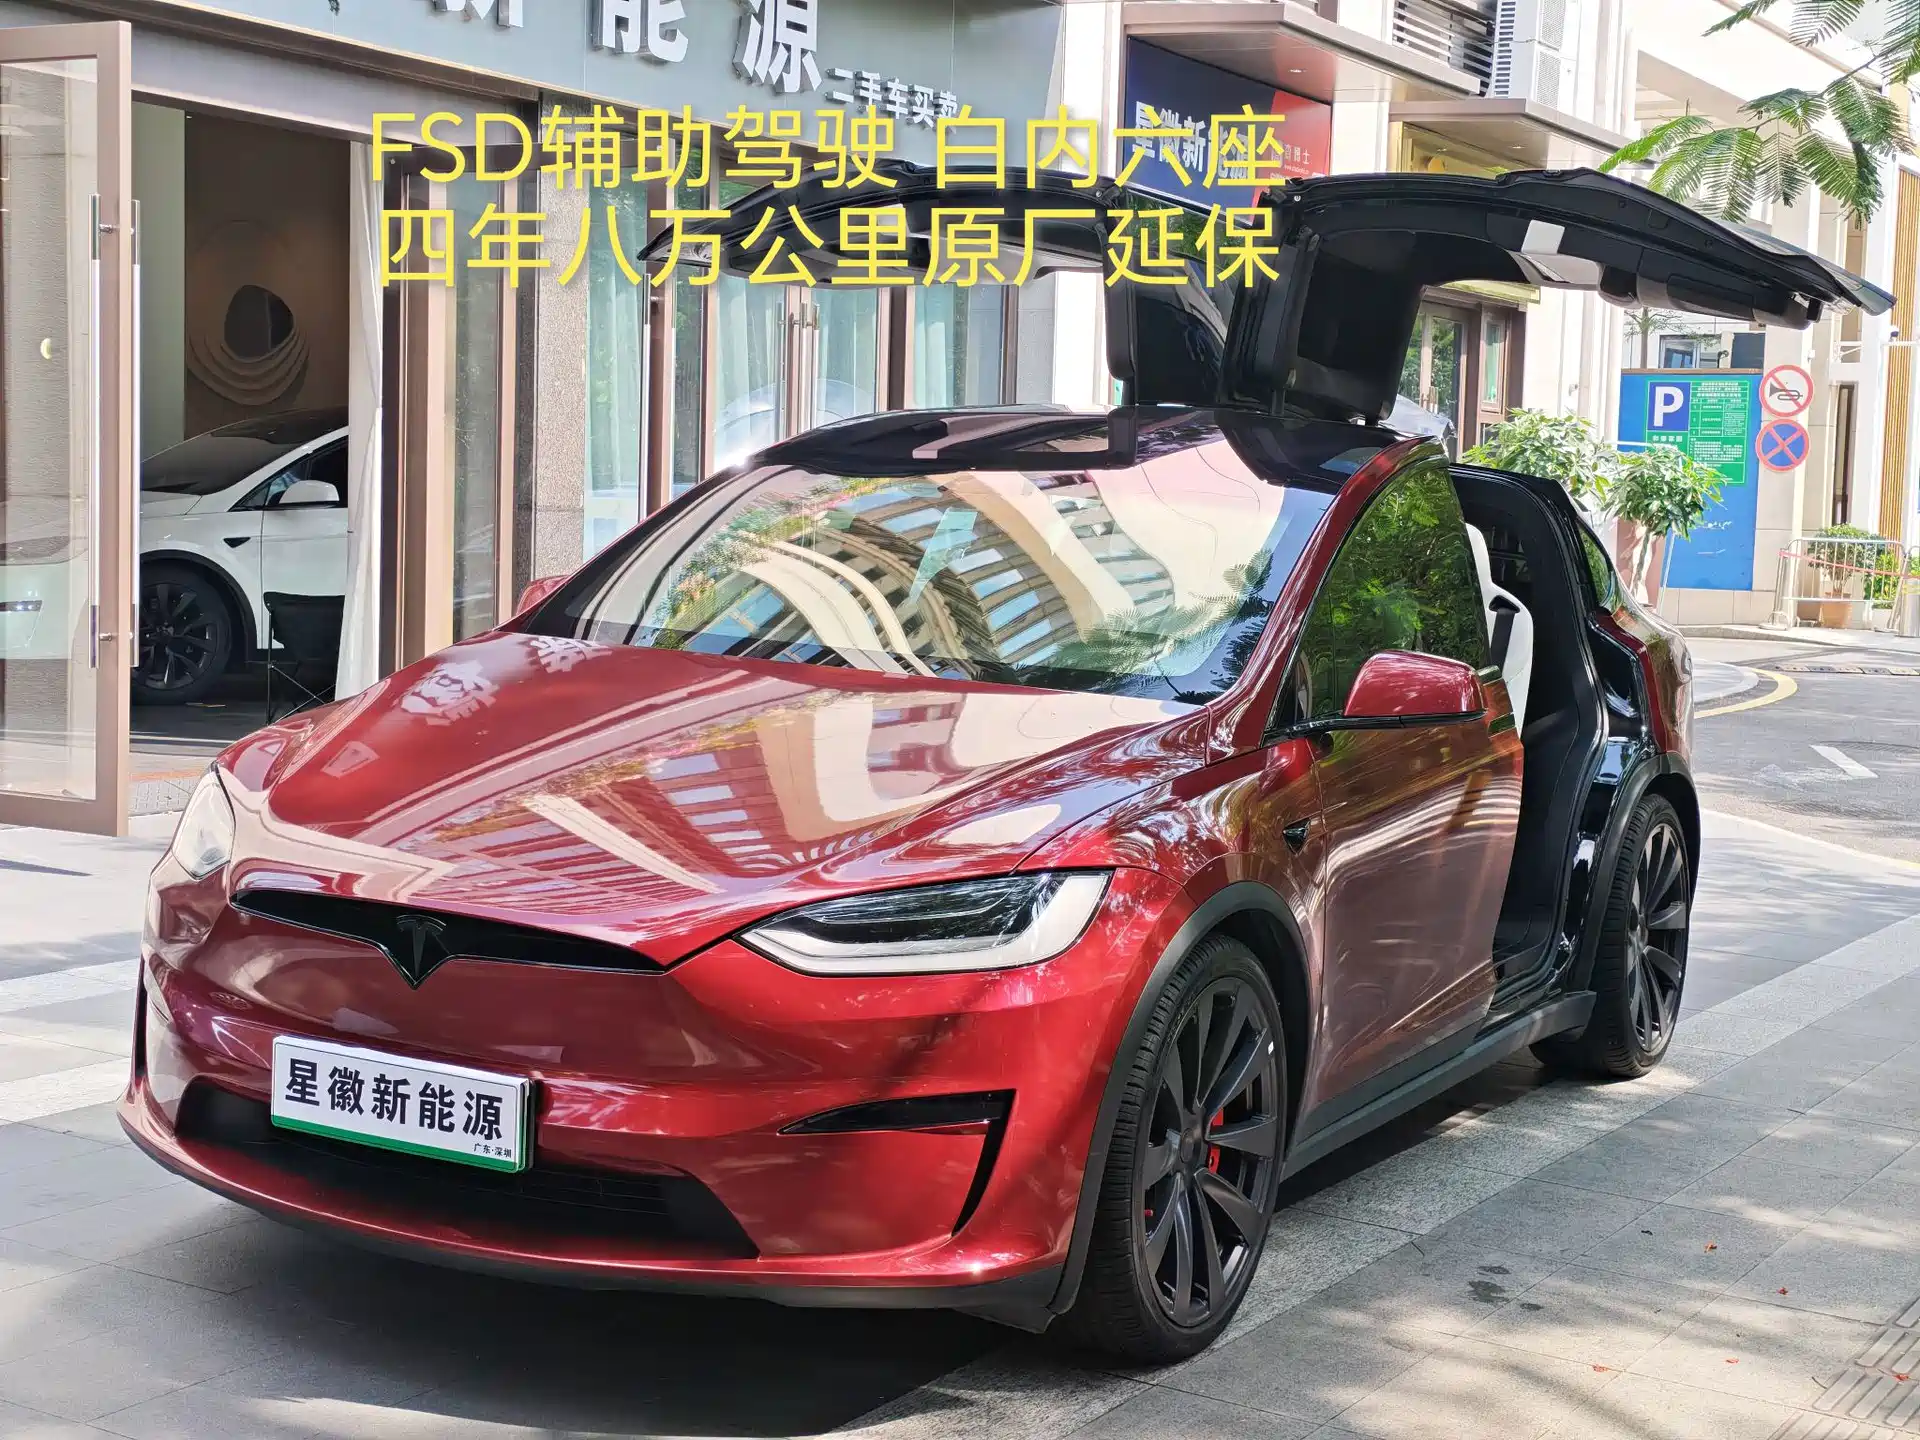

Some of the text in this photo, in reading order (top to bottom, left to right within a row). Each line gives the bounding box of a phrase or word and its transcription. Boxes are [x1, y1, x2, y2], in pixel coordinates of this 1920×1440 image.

[832, 67, 957, 134] 二手车买卖
[1653, 386, 1684, 427] P
[285, 1057, 503, 1141] 星徽新能源
[473, 1142, 512, 1159] 广东·深圳
